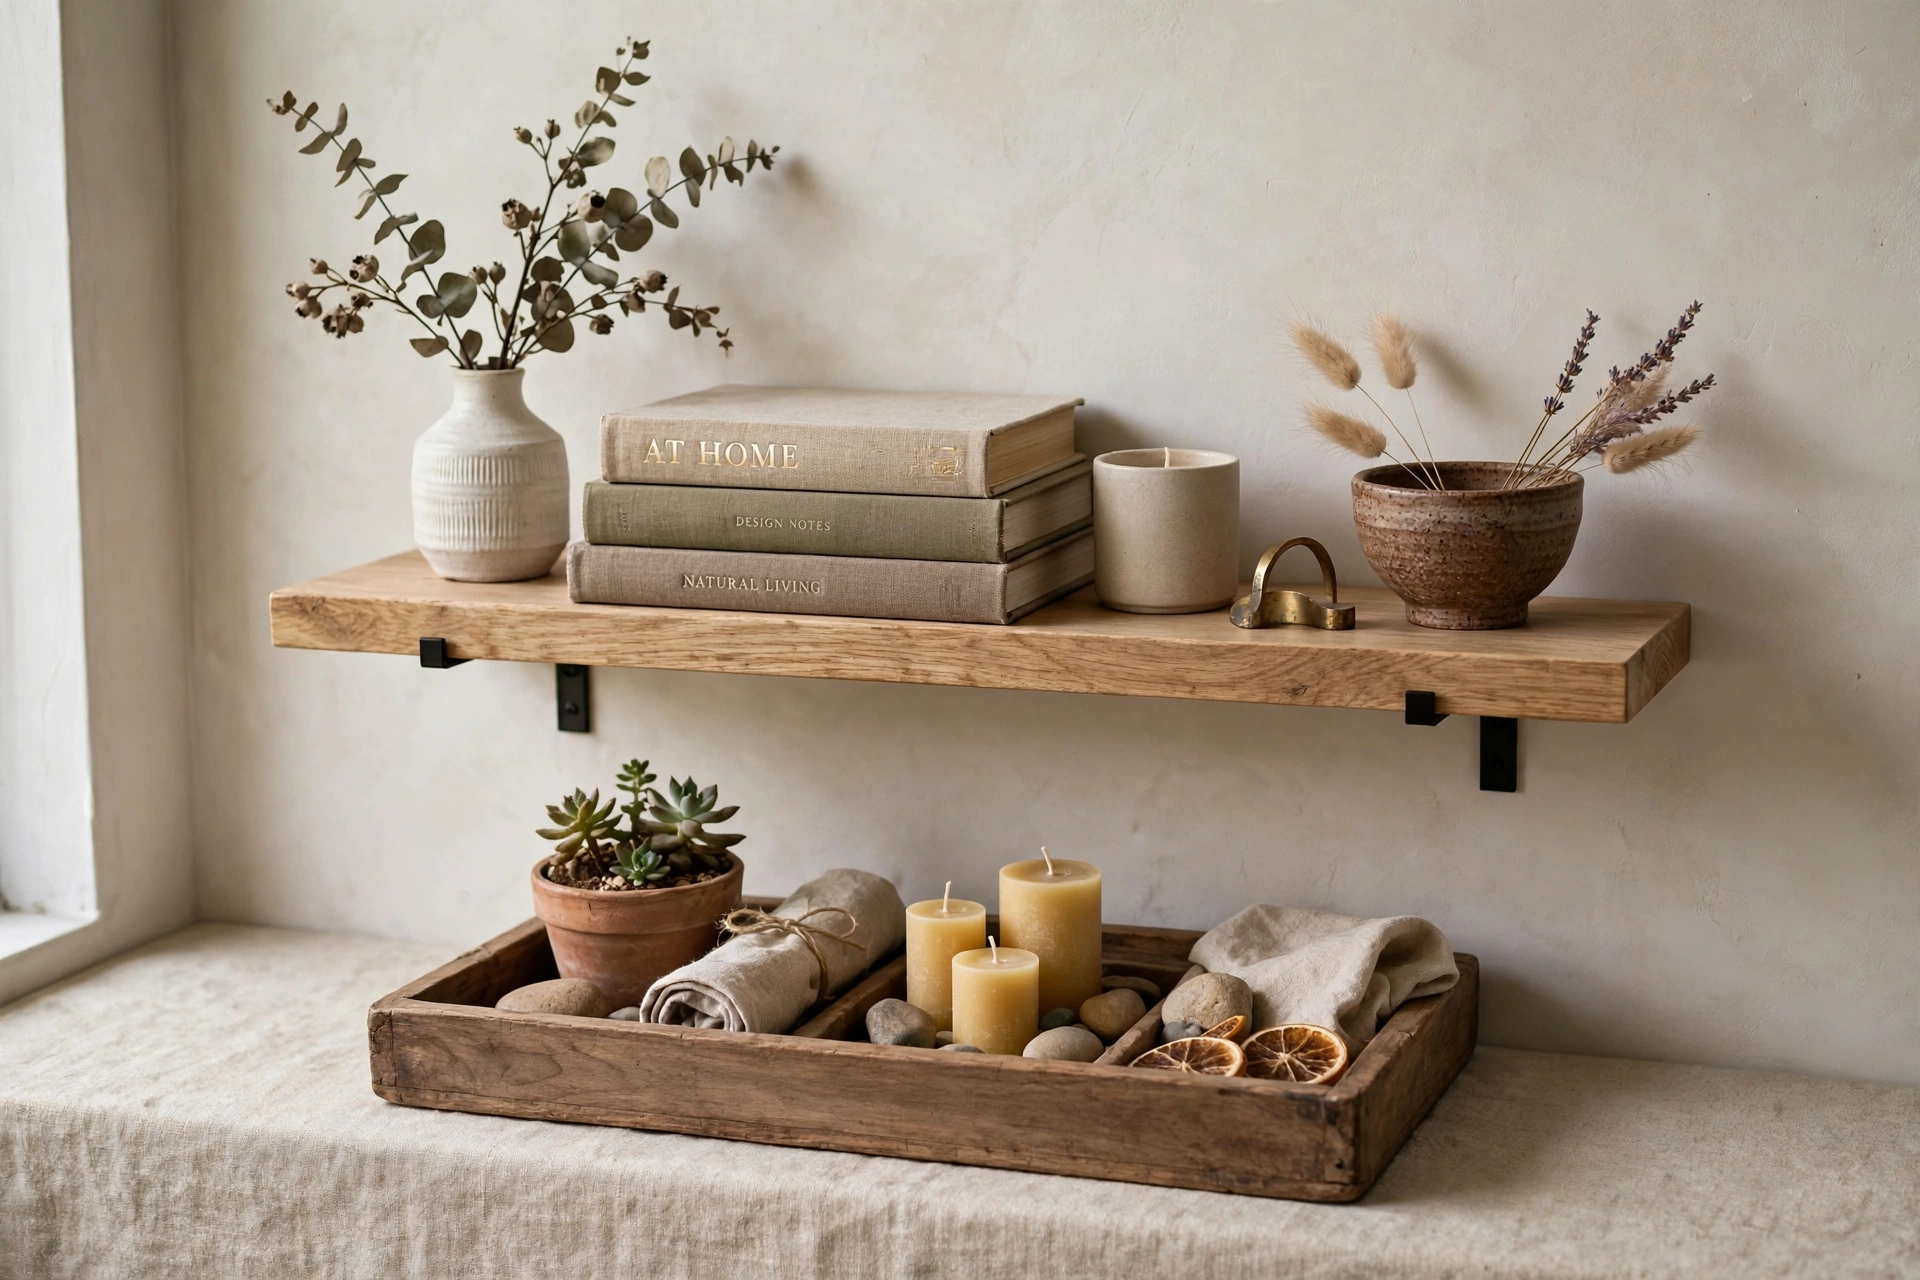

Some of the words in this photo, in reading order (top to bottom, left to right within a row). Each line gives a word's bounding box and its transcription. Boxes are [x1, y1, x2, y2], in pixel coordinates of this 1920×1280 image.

[643, 438, 684, 464] AT
[699, 441, 799, 469] HOME
[736, 516, 783, 529] DESIGN
[789, 518, 831, 531] NOTES
[682, 574, 759, 591] NATURAL
[765, 578, 821, 594] LIVING
